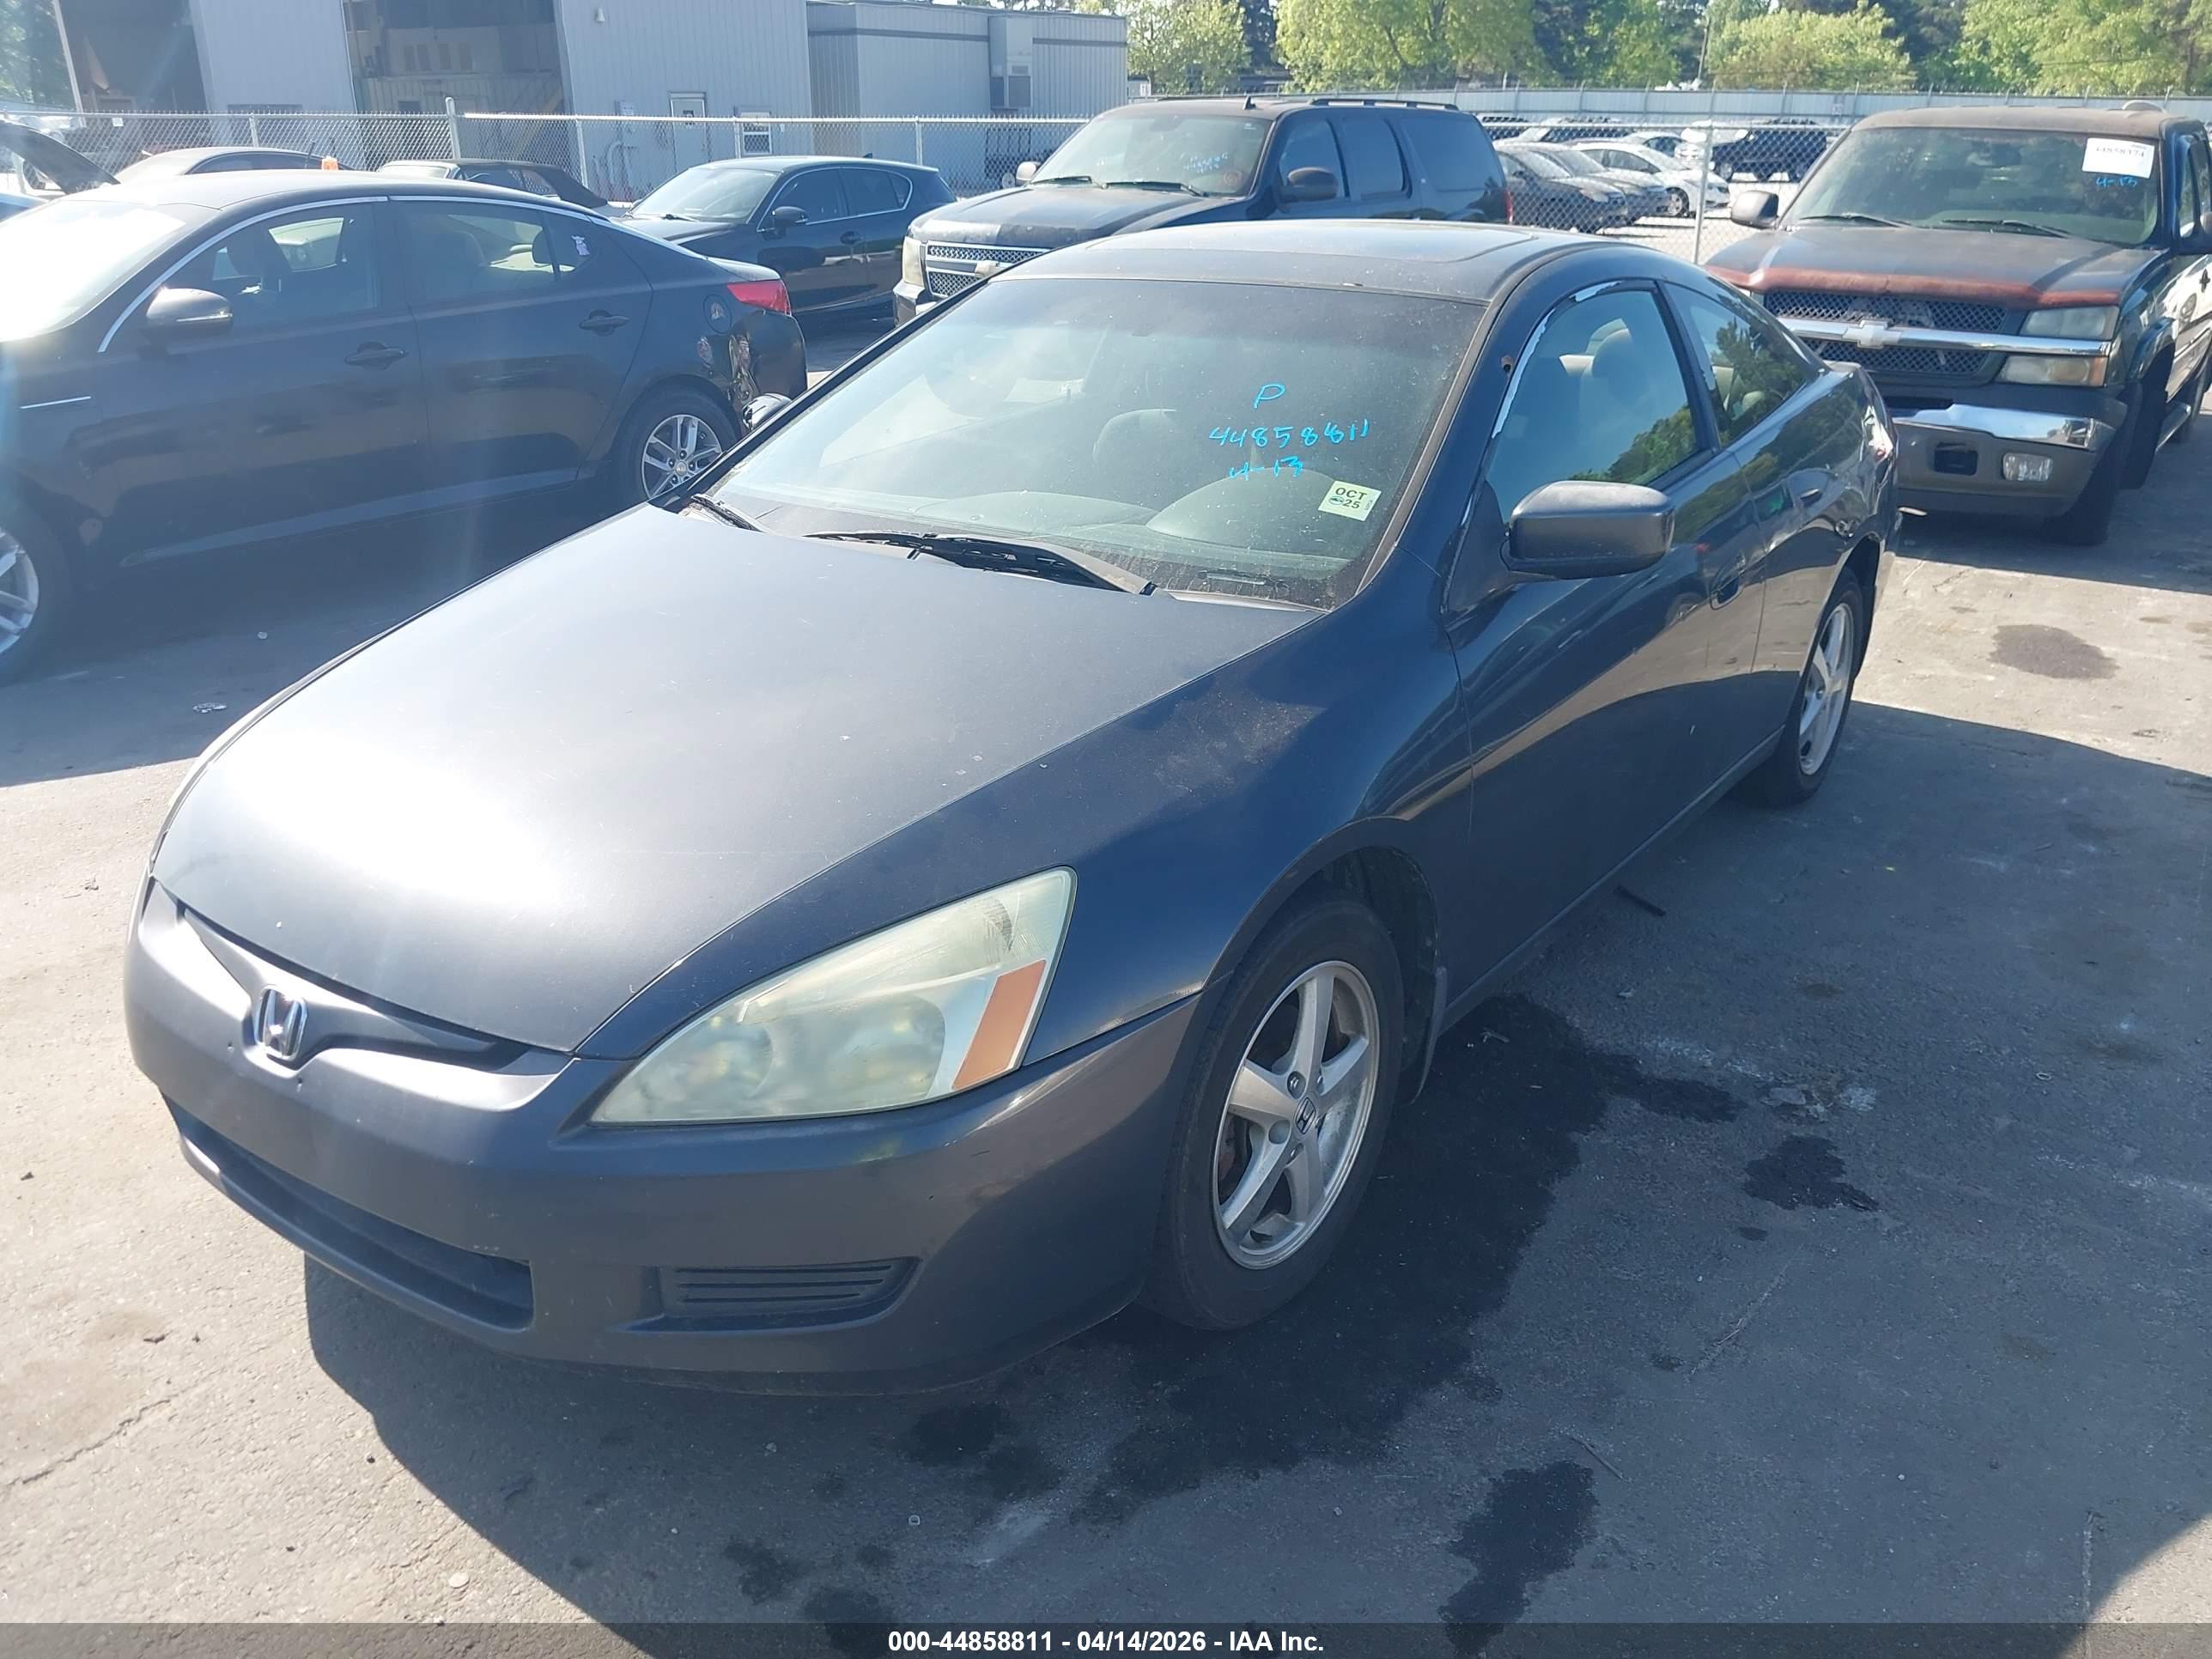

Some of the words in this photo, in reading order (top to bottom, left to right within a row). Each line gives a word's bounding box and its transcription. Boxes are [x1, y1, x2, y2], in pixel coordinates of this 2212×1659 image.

[1254, 383, 1286, 409] P
[1229, 455, 1304, 481] 4-13
[1335, 487, 1368, 501] OCT
[1342, 499, 1361, 509] 25
